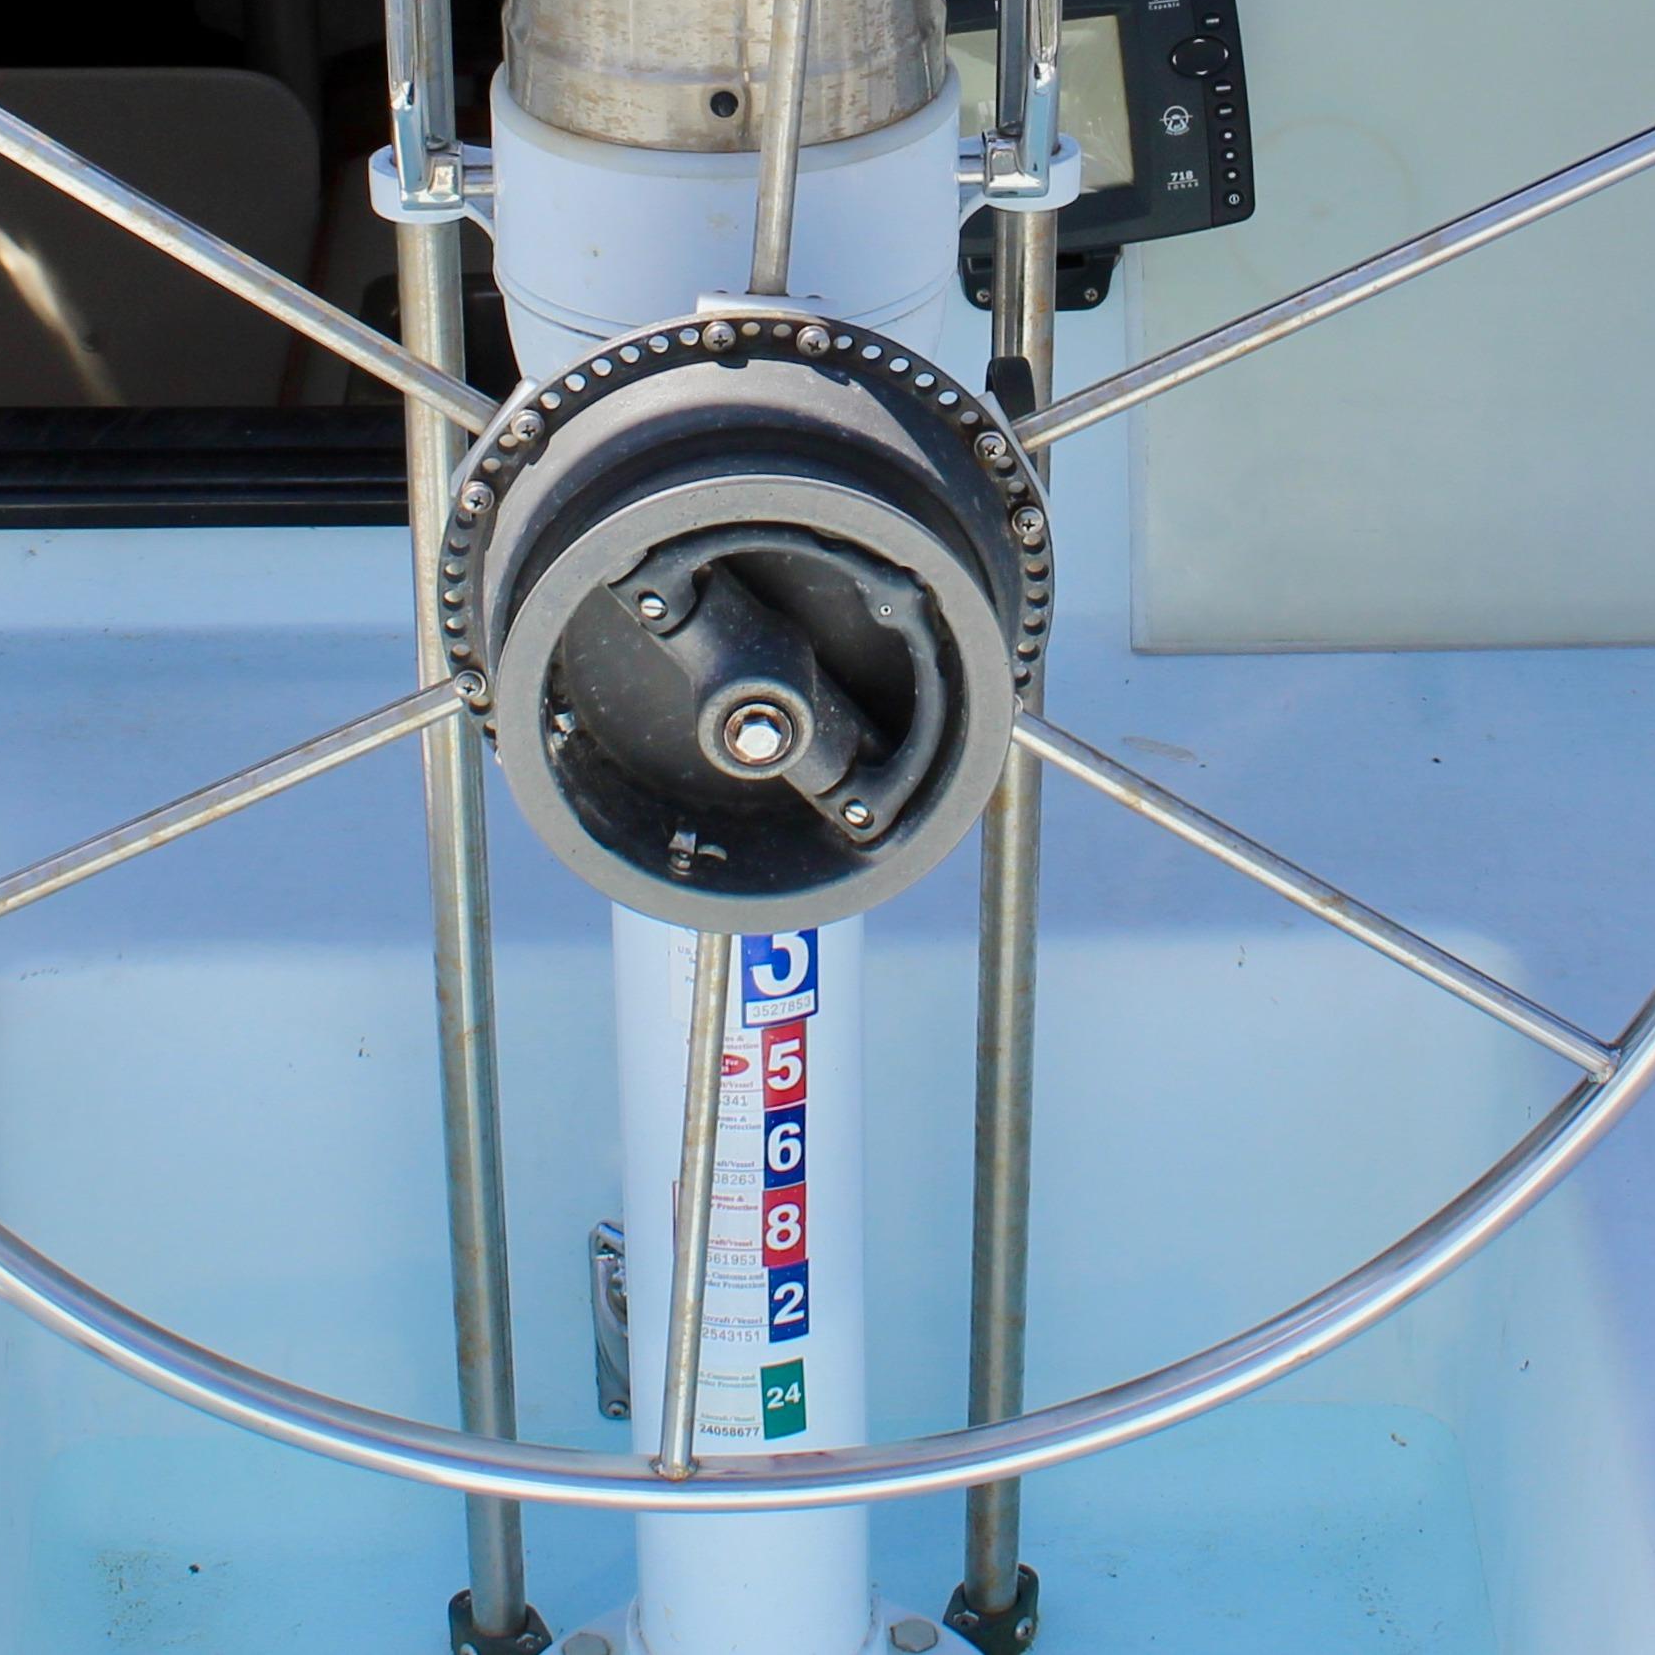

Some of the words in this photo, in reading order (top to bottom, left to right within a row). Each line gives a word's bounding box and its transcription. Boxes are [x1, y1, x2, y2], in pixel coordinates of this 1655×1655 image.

[1170, 169, 1194, 182] 718
[752, 995, 812, 1019] 3527853
[767, 1038, 803, 1091] 5
[767, 1122, 802, 1173] 6
[765, 1202, 802, 1251] 8
[772, 1281, 805, 1326] 2
[766, 1381, 802, 1410] 24
[699, 1423, 760, 1438] 24058677
